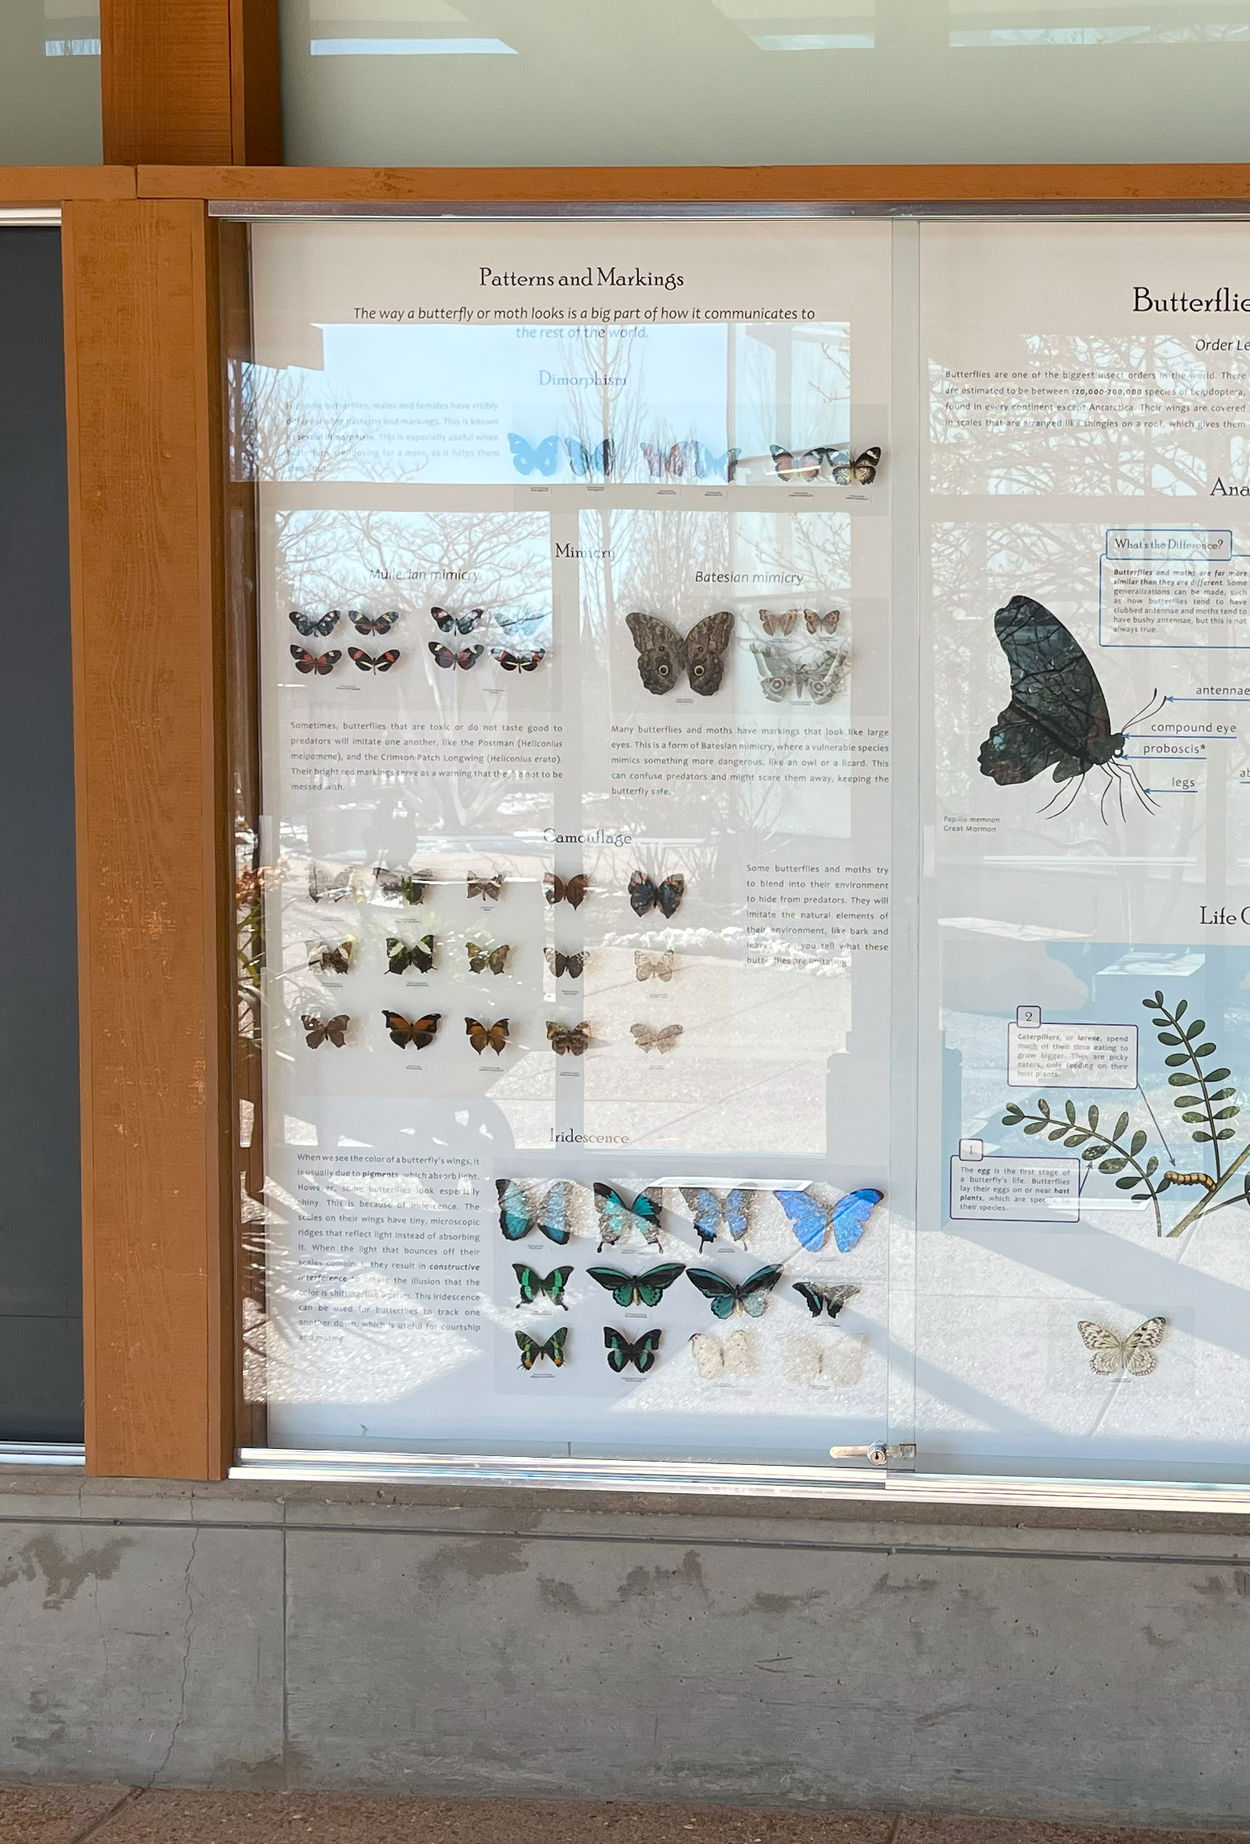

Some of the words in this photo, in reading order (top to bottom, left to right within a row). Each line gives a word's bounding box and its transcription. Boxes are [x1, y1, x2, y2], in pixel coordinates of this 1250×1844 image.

[480, 267, 554, 286] Patterns
[558, 267, 591, 286] and
[597, 267, 684, 291] Markings
[354, 307, 376, 319] The
[379, 310, 404, 322] way
[407, 310, 414, 319] a
[418, 306, 473, 322] butterfly
[476, 310, 489, 319] or
[494, 307, 527, 319] moth
[531, 307, 564, 319] looks
[567, 308, 576, 319] is
[580, 310, 587, 318] a
[591, 307, 610, 323] big
[613, 309, 640, 321] part
[644, 306, 658, 321] of
[661, 307, 688, 319] how
[692, 308, 700, 319] it
[704, 308, 797, 319] communicates
[801, 309, 815, 319] to
[516, 326, 537, 338] the
[540, 327, 564, 338] rest
[567, 326, 581, 341] of
[584, 325, 606, 338] the
[609, 326, 649, 338] world.
[1195, 338, 1232, 351] Order
[538, 369, 627, 389] Dimorphism
[1115, 538, 1148, 550] What's
[1150, 538, 1166, 550] the
[555, 543, 616, 561] Mimicry
[695, 571, 748, 582] Batesian
[753, 572, 803, 586] mimicry
[1196, 686, 1250, 695] antennae
[611, 725, 633, 734] Many
[637, 725, 682, 733] butterflies
[761, 727, 799, 737] markings
[867, 729, 889, 739] large
[1150, 723, 1213, 734] compound
[1216, 725, 1237, 734] eye
[1172, 777, 1195, 789] legs
[543, 828, 633, 847] Camouflage
[746, 864, 770, 872] Some
[774, 864, 819, 872] butterflies
[824, 865, 840, 873] and
[845, 865, 871, 873] moths
[876, 867, 888, 875] try
[758, 895, 776, 903] hide
[780, 895, 800, 903] from
[803, 896, 847, 905] predators.
[851, 896, 870, 906] They
[1200, 906, 1236, 925] Life
[1025, 1011, 1032, 1021] 2
[550, 1128, 629, 1143] Iridescence
[1038, 1169, 1058, 1177] stage
[298, 1228, 323, 1238] ridges
[345, 1229, 371, 1237] reflect
[374, 1231, 392, 1240] light
[395, 1231, 424, 1239] instead
[438, 1233, 480, 1243] absorbing
